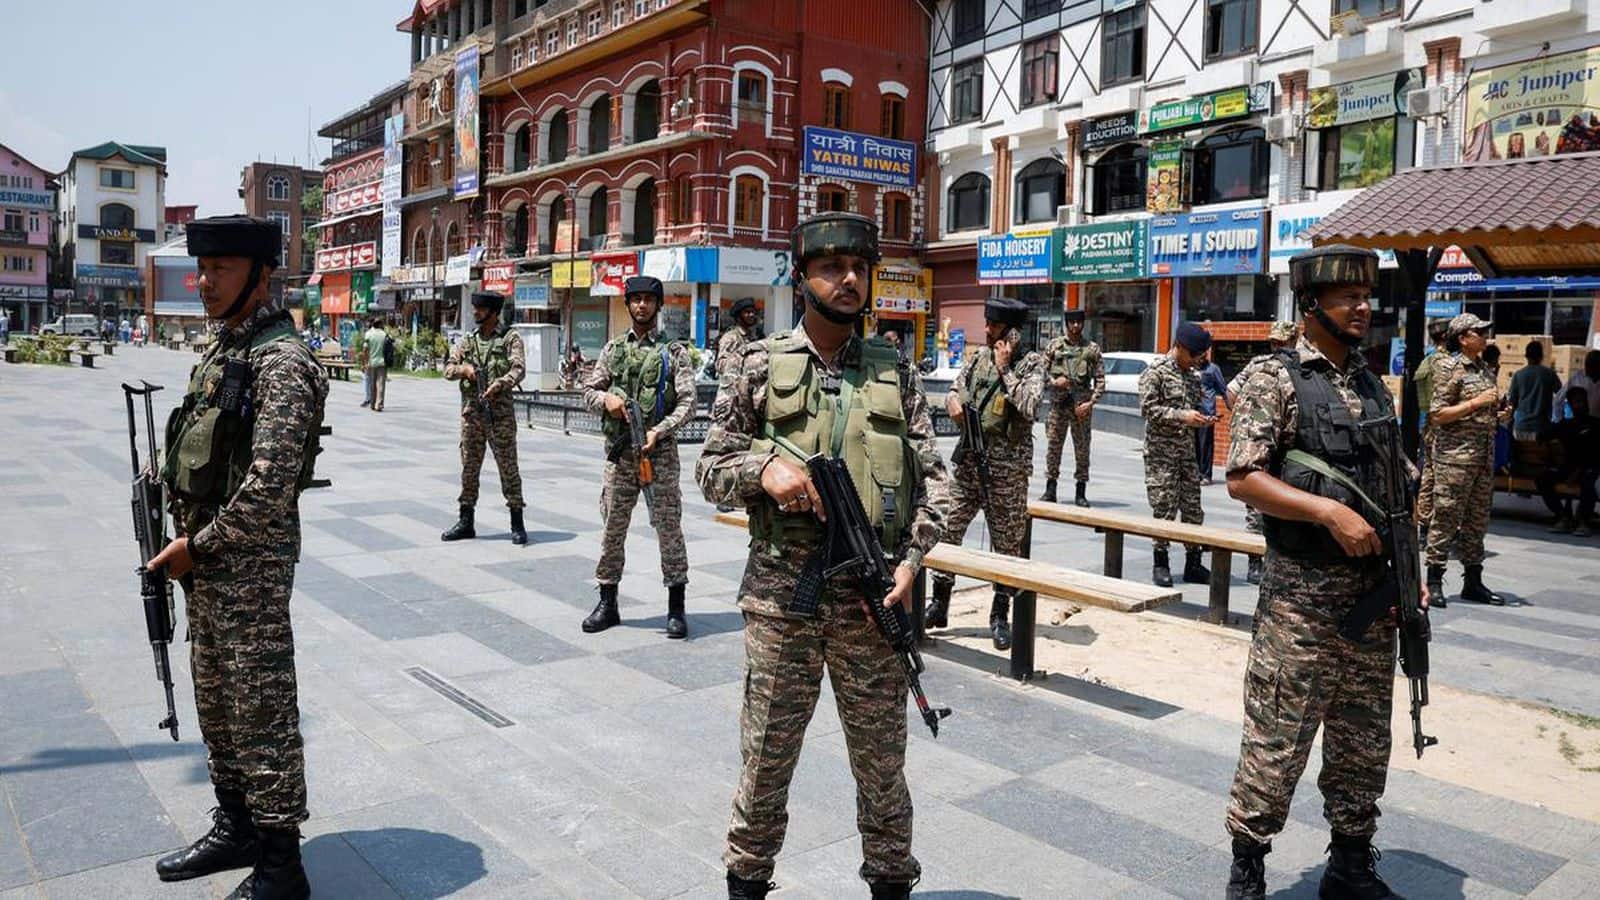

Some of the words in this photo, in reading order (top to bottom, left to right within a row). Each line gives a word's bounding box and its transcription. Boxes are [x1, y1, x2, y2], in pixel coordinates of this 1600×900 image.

[1516, 67, 1597, 97] Juniper
[1340, 93, 1392, 112] Juniper
[1086, 125, 1137, 141] EDUCATION
[1096, 116, 1127, 130] NEEDS
[810, 134, 857, 152] यात्री
[862, 138, 913, 161] निवास
[812, 149, 858, 167] YATRI
[863, 156, 911, 174] NIWAS
[0, 191, 51, 204] ESTAURANT
[981, 241, 1002, 258] FIDA
[1005, 238, 1047, 256] HOISERY
[1081, 230, 1135, 250] DESTINY
[1151, 234, 1188, 256] TIME
[1205, 229, 1258, 252] SOUND
[879, 272, 914, 282] SAMSUNG
